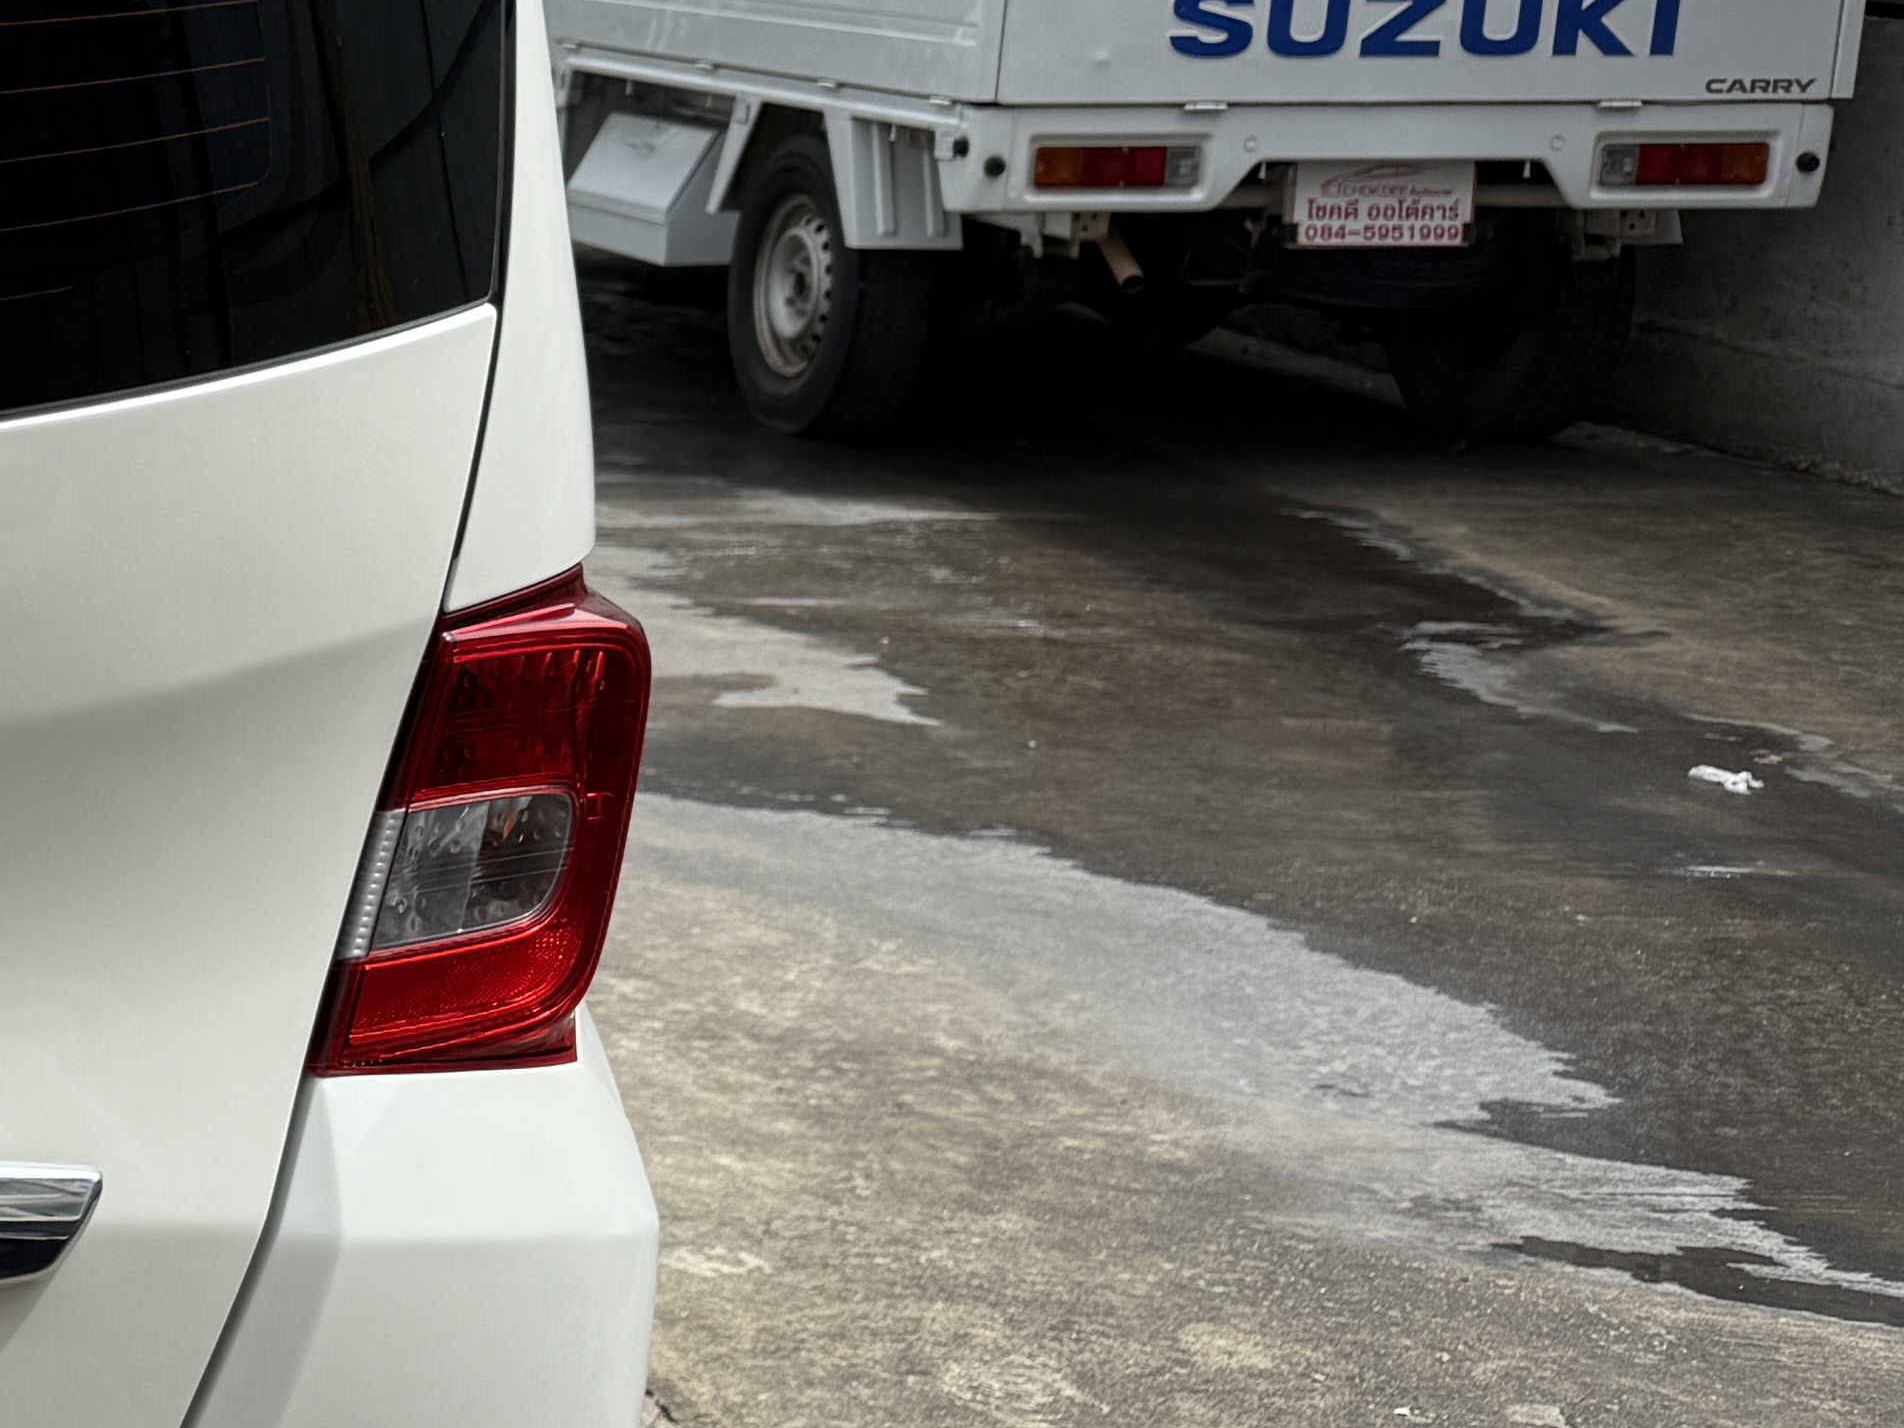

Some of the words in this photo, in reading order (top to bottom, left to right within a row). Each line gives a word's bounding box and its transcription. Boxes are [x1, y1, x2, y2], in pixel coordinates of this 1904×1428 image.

[1705, 78, 1817, 95] CARRY
[1307, 197, 1359, 221] โชคดี
[1367, 197, 1461, 221] ออโต้คาร์
[1304, 223, 1461, 241] 084-5951999
